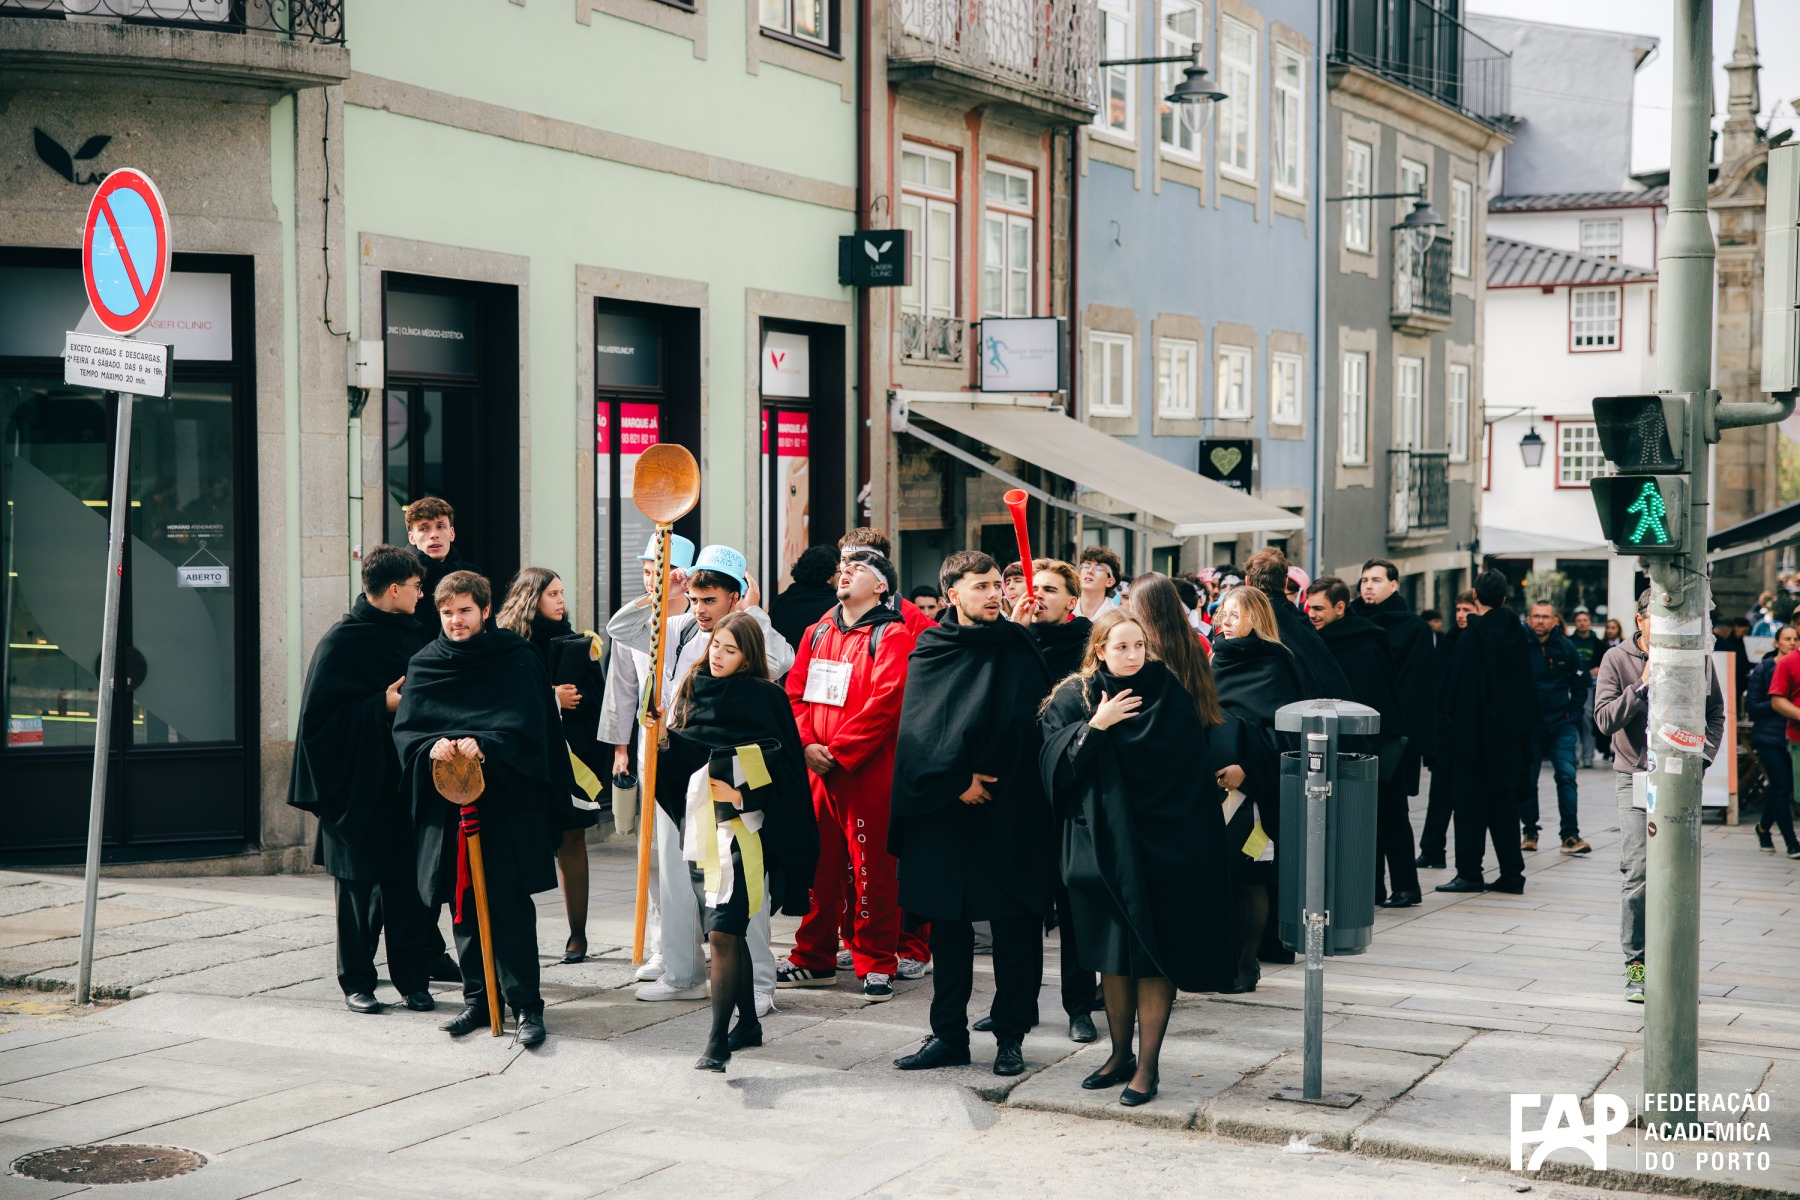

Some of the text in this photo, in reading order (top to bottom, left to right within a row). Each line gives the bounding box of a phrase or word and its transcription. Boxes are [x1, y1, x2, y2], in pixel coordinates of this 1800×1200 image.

[146, 320, 213, 330] ASER CLINIC
[70, 343, 92, 354] EXCETO
[93, 346, 117, 357] CARGAS
[119, 349, 123, 358] E
[73, 356, 89, 366] FEIRA
[124, 362, 137, 371] DAS
[80, 368, 99, 378] TEMPO
[100, 369, 124, 382] MÁXIMO
[125, 375, 134, 383] 20
[621, 416, 658, 429] MARQUE JÁ
[186, 573, 222, 581] ABERTO
